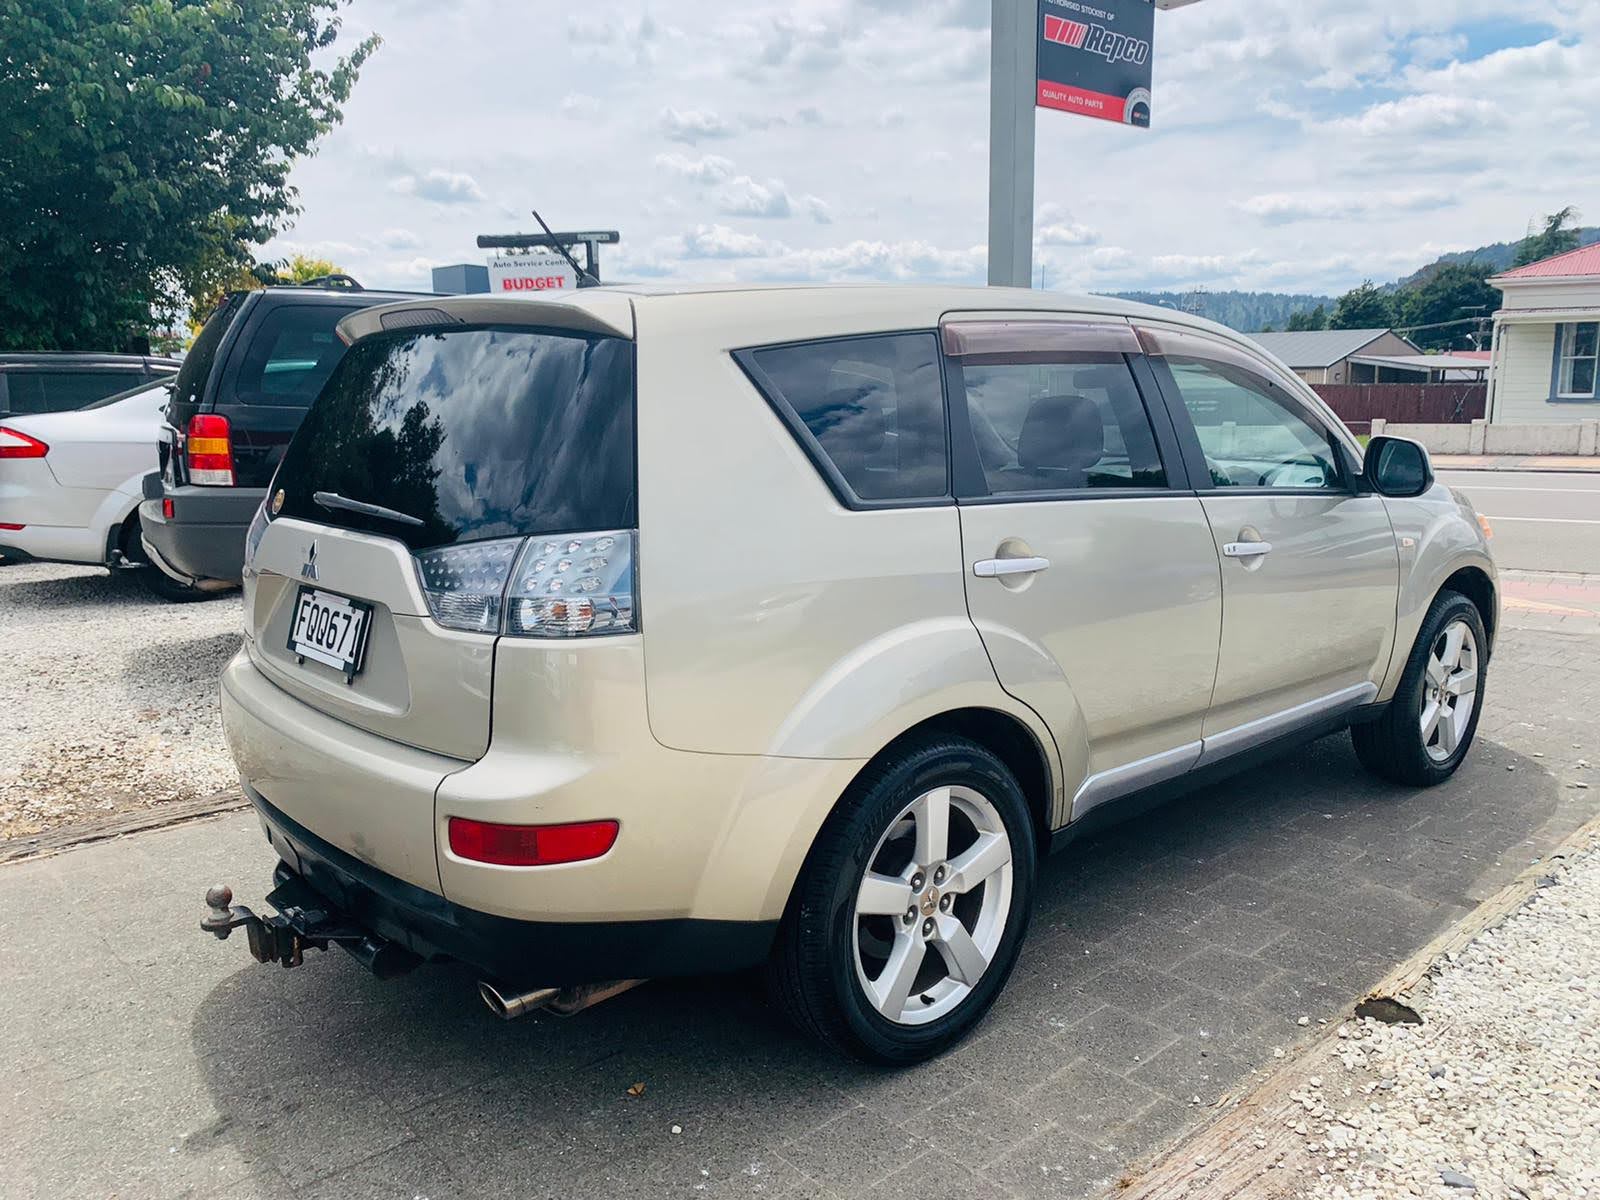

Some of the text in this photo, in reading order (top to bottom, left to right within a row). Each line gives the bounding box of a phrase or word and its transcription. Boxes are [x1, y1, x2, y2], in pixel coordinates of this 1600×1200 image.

[1081, 5, 1106, 19] STOCKIST
[1085, 23, 1150, 65] Repco
[1042, 89, 1104, 110] QUALITY AUTO PARTS
[493, 261, 511, 269] Auto
[513, 260, 542, 268] Service
[502, 275, 565, 291] BUDGET
[296, 600, 361, 657] FQQ671
